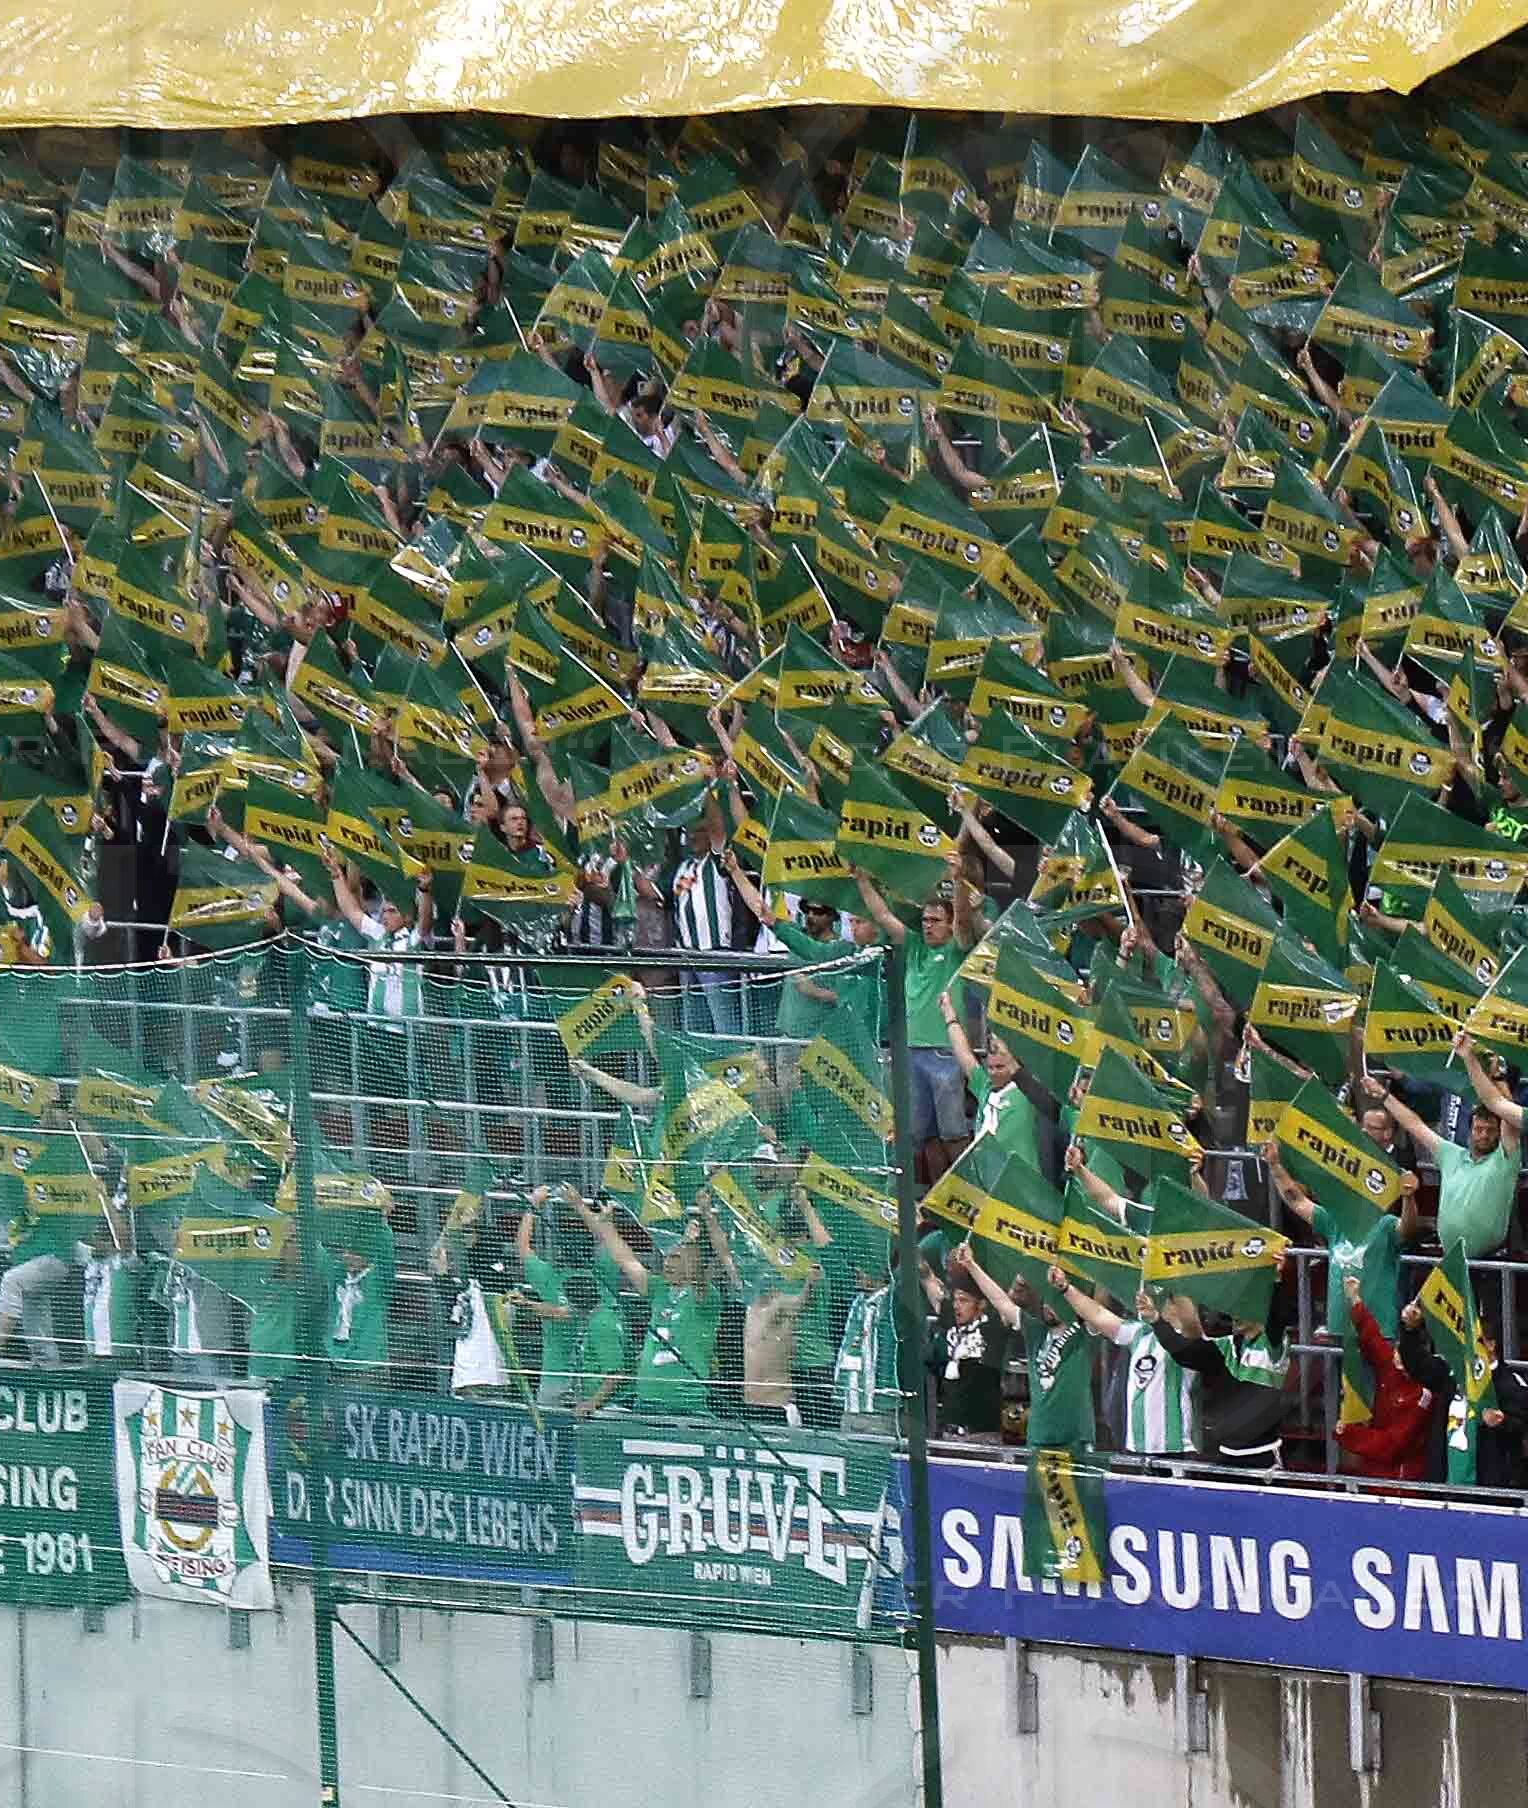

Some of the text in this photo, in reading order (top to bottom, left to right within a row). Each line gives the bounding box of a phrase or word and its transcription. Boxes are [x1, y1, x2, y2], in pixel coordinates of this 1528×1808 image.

[502, 517, 562, 543] rapid
[1132, 618, 1195, 651] rapid
[177, 704, 230, 725] rapid
[1331, 731, 1402, 769] rapid
[976, 766, 1046, 790] rapid
[1142, 764, 1204, 813] rapid
[1234, 794, 1302, 819] rapid
[260, 814, 316, 842] rapid
[842, 814, 910, 841] rapid
[774, 845, 841, 871] rapid
[1202, 915, 1263, 956] rapid
[994, 997, 1054, 1037] rapid
[1383, 1021, 1456, 1046] rapid
[1097, 1111, 1162, 1139] rapid
[1299, 1129, 1363, 1179] rapid
[1162, 1239, 1235, 1268] rapid
[345, 1403, 558, 1481] SK RAPID WIEN
[342, 1478, 401, 1534] SINN
[411, 1487, 457, 1541] DES
[465, 1495, 558, 1553] LEBENS
[24, 1532, 93, 1574] 1981
[941, 1507, 1312, 1620] SASUNG
